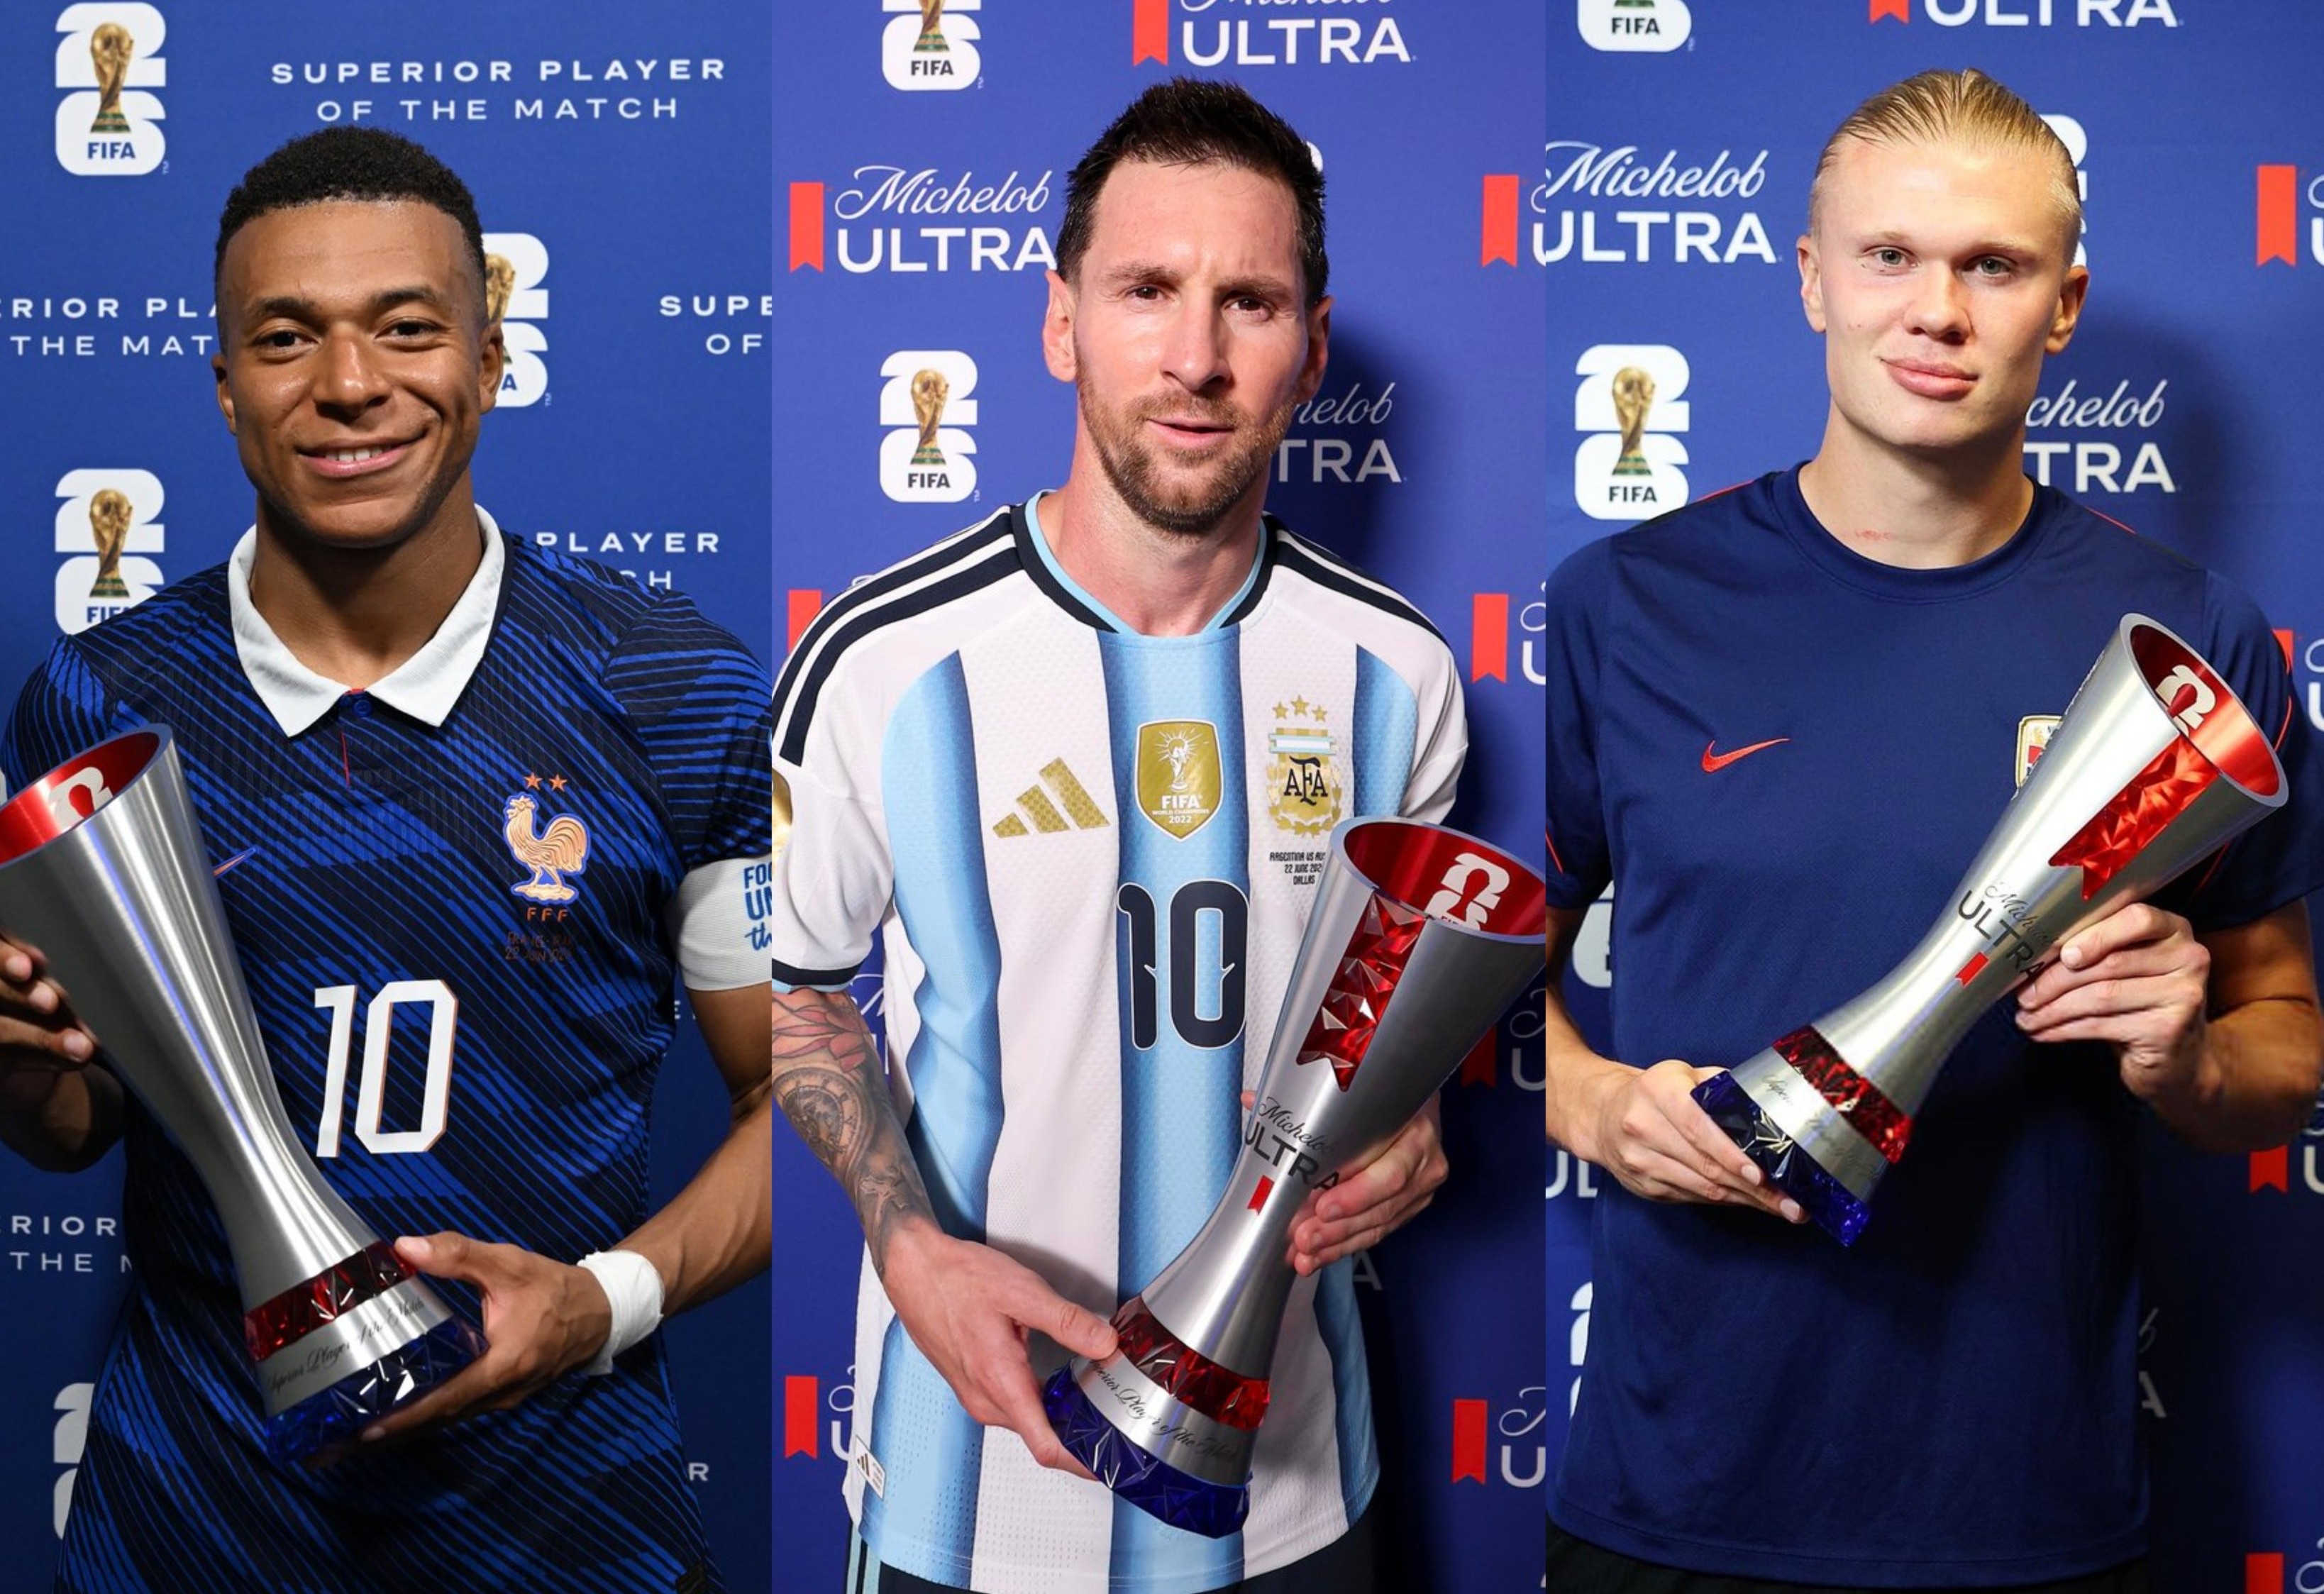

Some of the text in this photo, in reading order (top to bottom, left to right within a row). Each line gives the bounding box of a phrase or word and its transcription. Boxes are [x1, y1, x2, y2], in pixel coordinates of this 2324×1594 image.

[1612, 17, 1660, 34] FIFA
[1183, 18, 1412, 67] ULTRA
[272, 59, 724, 84] SUPERIOR PLAYER
[911, 60, 953, 76] FIFA
[317, 98, 677, 122] OF THE MATCH
[87, 142, 136, 160] FIFA
[1531, 140, 1769, 213] Michelob
[834, 165, 1053, 220] Michelob
[1533, 211, 1777, 265] ULTRA
[838, 227, 1058, 273] ULTRA
[0, 298, 119, 319] RIOR
[660, 296, 772, 316] SUPE
[10, 336, 213, 355] THE MAT
[706, 333, 763, 355] OF
[2025, 380, 2168, 428] chelob
[1279, 438, 1402, 484] TRA
[2023, 442, 2176, 493] TRA
[907, 473, 951, 488] FIFA
[1609, 486, 1657, 502] FIFA
[536, 532, 719, 553] PLAYER
[1283, 756, 1329, 806] AFA
[1161, 795, 1200, 809] FIFA
[1270, 852, 1305, 861] ARGENTINA
[1285, 863, 1322, 873] 22 JUNE 202
[1293, 875, 1315, 885] DALLAS
[1117, 878, 1249, 1050] 10
[314, 979, 458, 1158] 10
[1245, 1122, 1339, 1190] ULTRA
[0, 1215, 117, 1236] RIOR
[9, 1251, 93, 1273] THE
